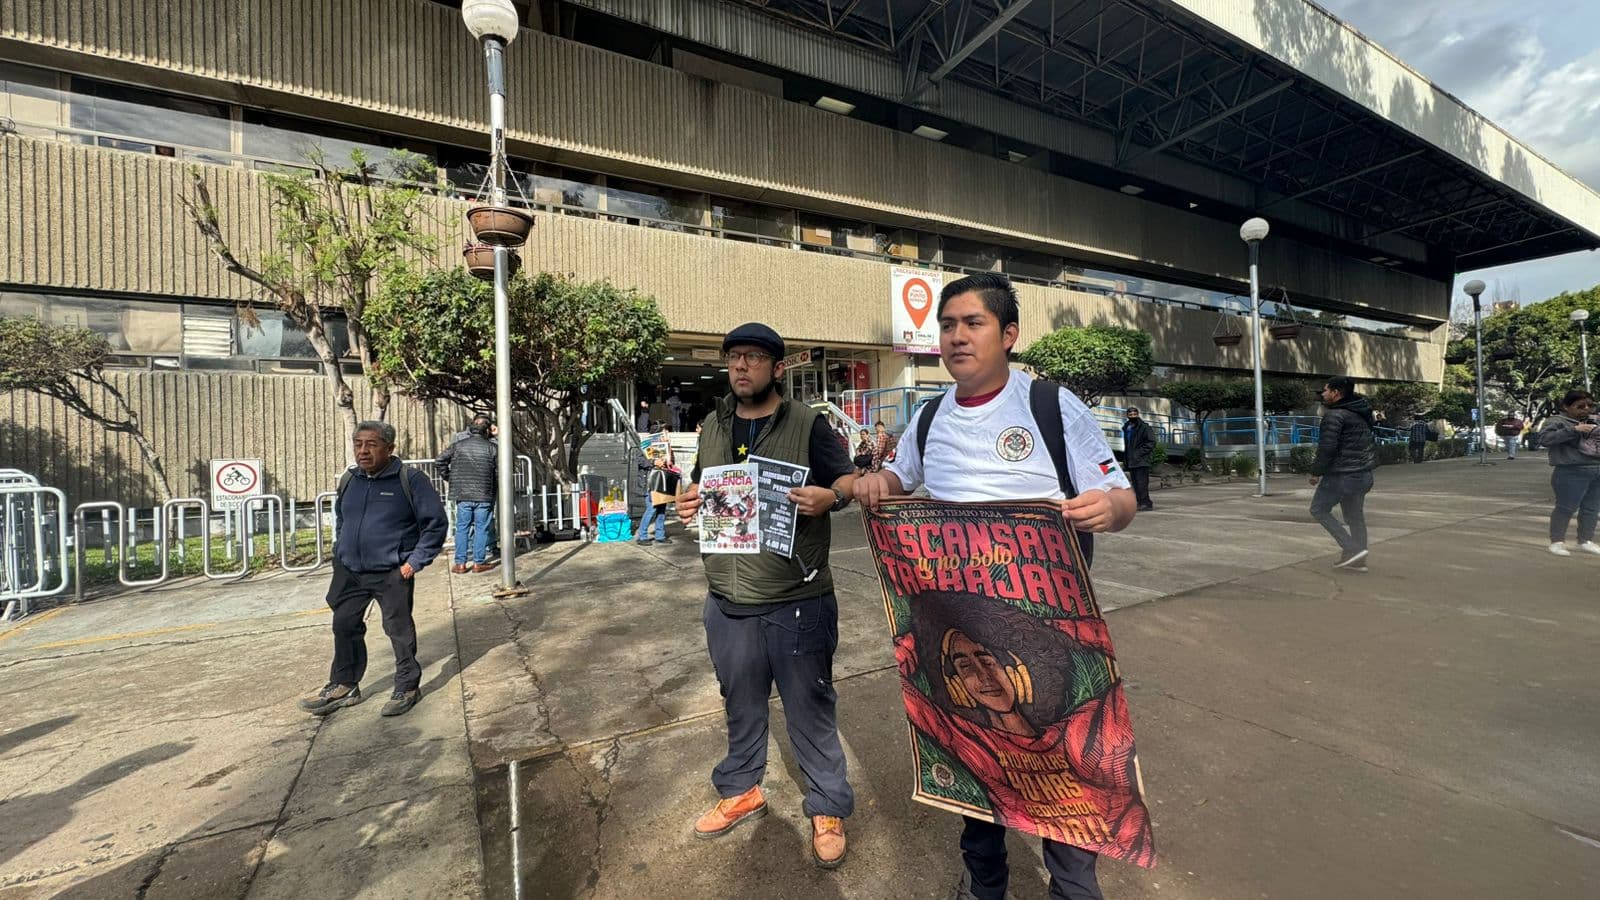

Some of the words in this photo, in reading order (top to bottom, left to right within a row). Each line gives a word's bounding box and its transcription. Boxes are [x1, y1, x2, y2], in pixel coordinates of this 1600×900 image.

[703, 476, 753, 489] VIOLENCIA
[898, 509, 945, 519] QUEREMOS
[944, 509, 978, 517] TIEMPO
[871, 521, 1071, 566] DESCANSAR
[938, 554, 960, 570] no
[969, 543, 1013, 568] solo
[882, 556, 1088, 616] TRABAJAR
[1021, 752, 1046, 771] POR
[1043, 753, 1070, 770] LAS
[1037, 773, 1084, 801] HRS
